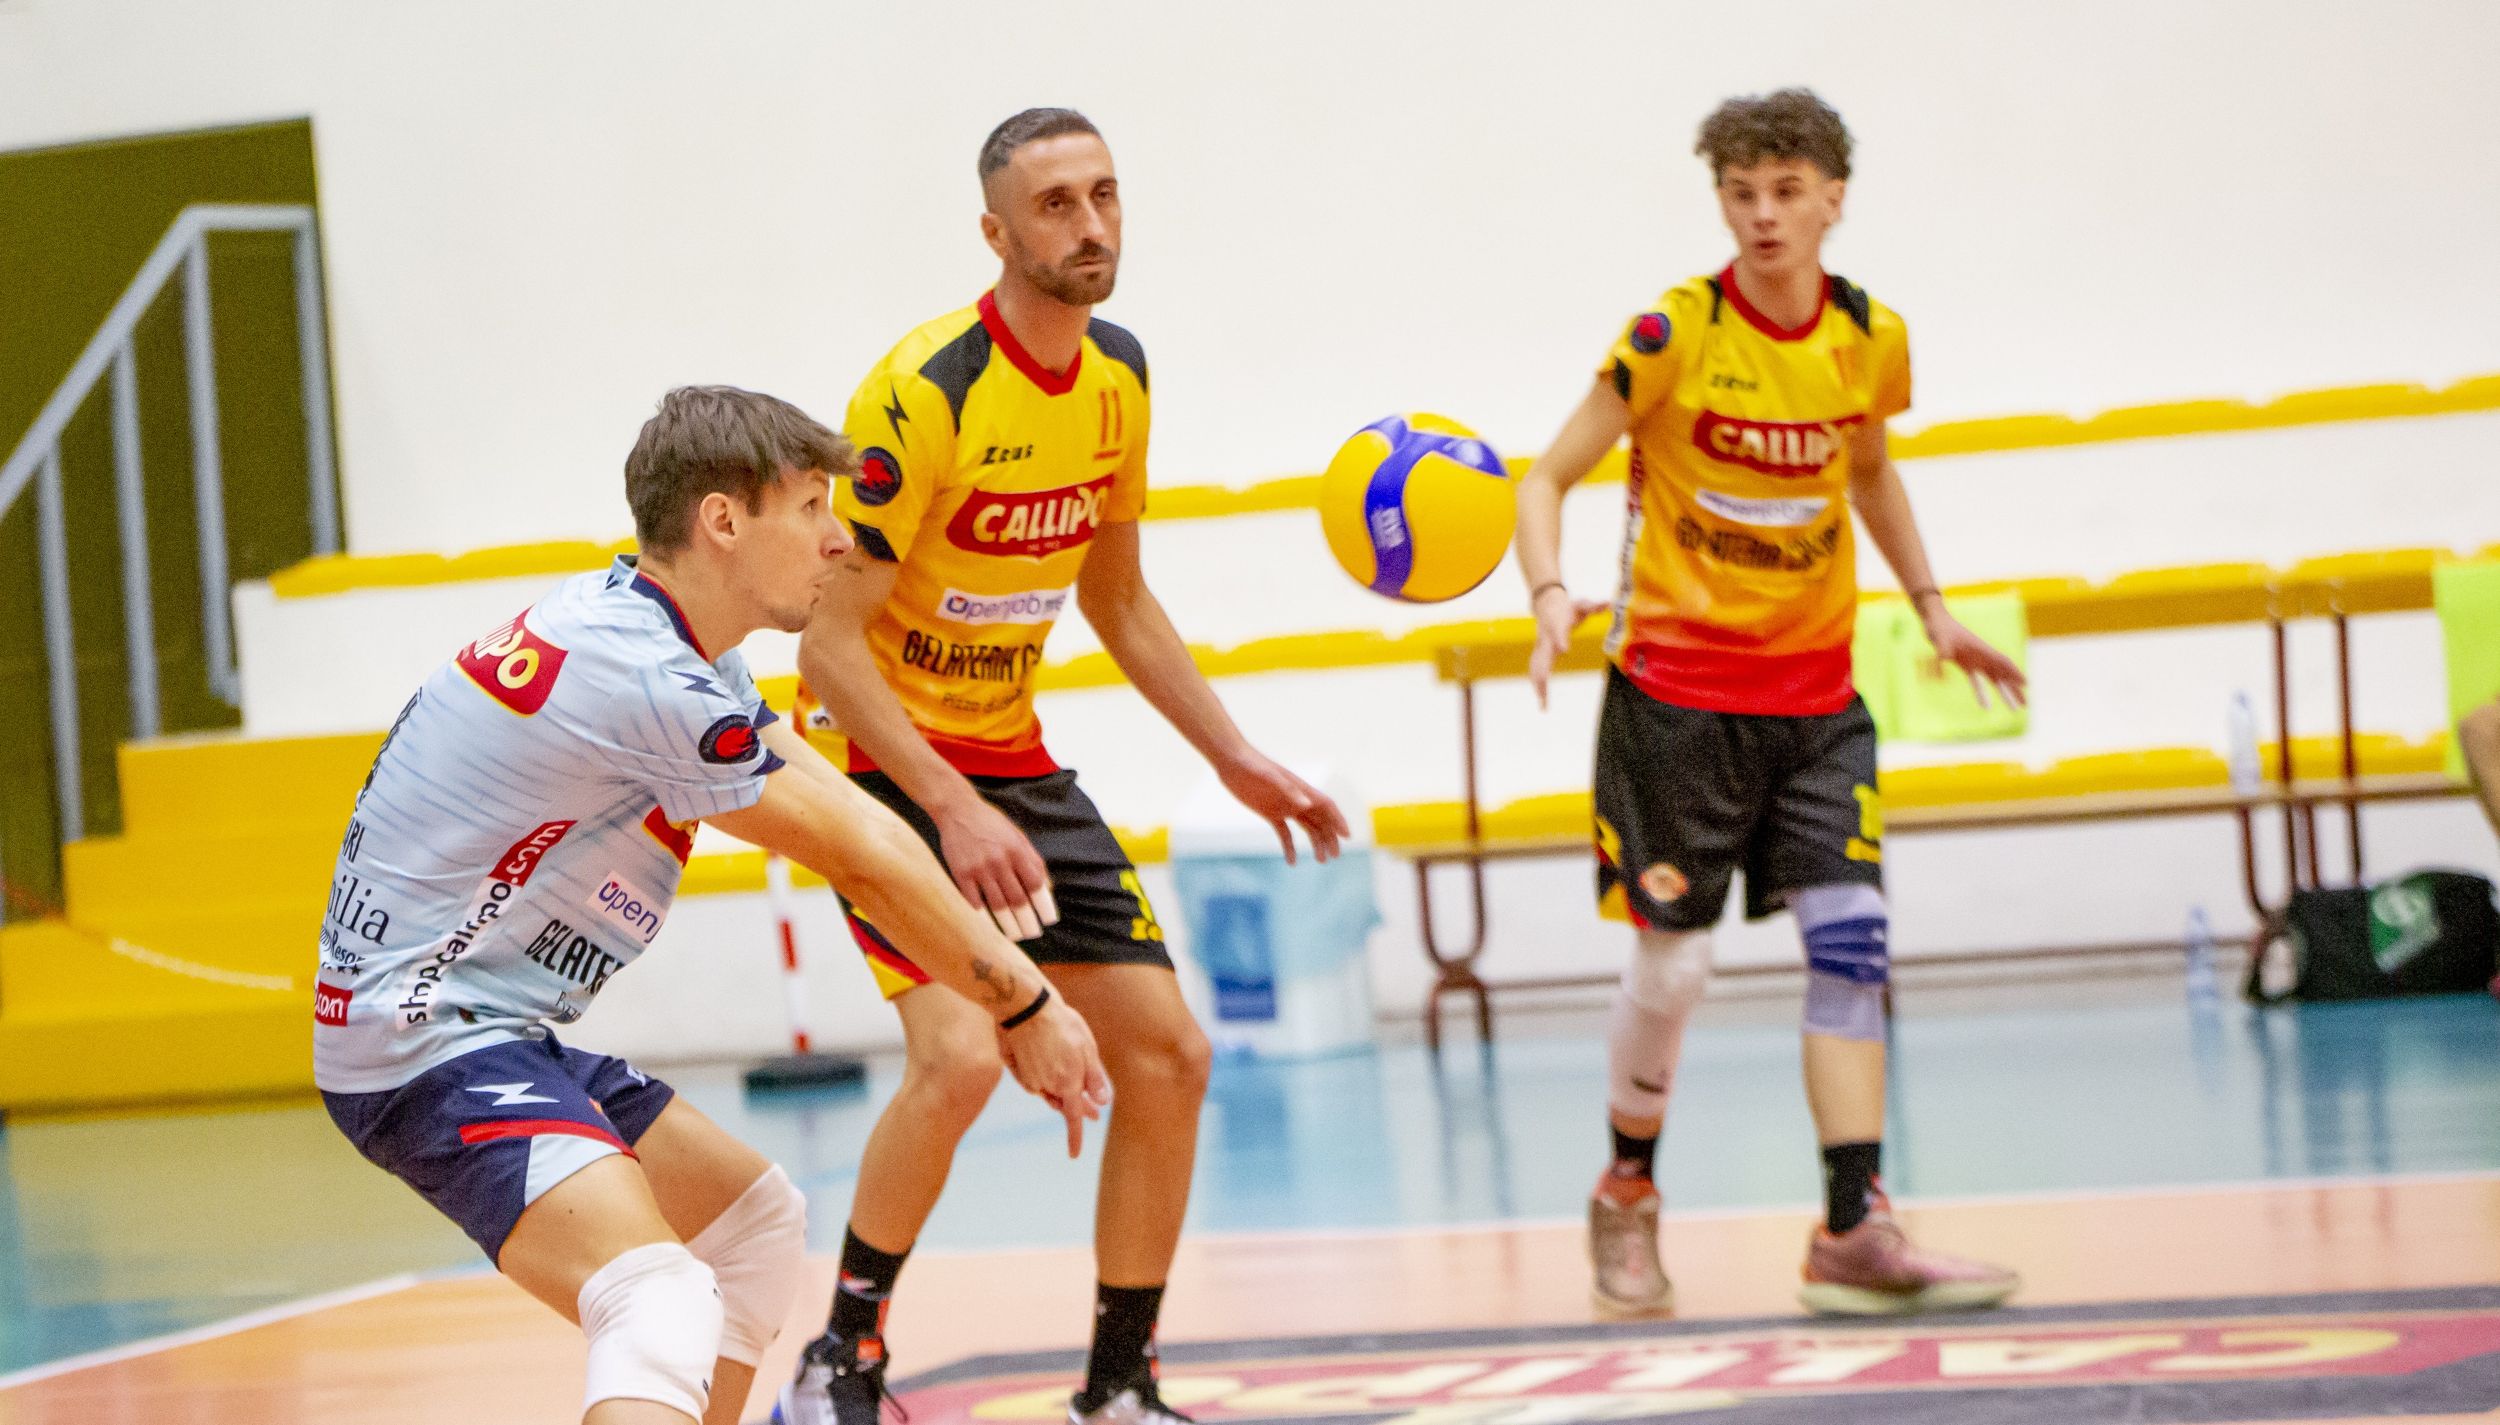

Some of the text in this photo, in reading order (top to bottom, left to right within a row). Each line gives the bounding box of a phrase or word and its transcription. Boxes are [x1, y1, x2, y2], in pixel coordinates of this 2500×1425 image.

[981, 444, 1034, 466] Zeus
[1709, 422, 1843, 467] CALLIP
[524, 918, 625, 995] GELATE
